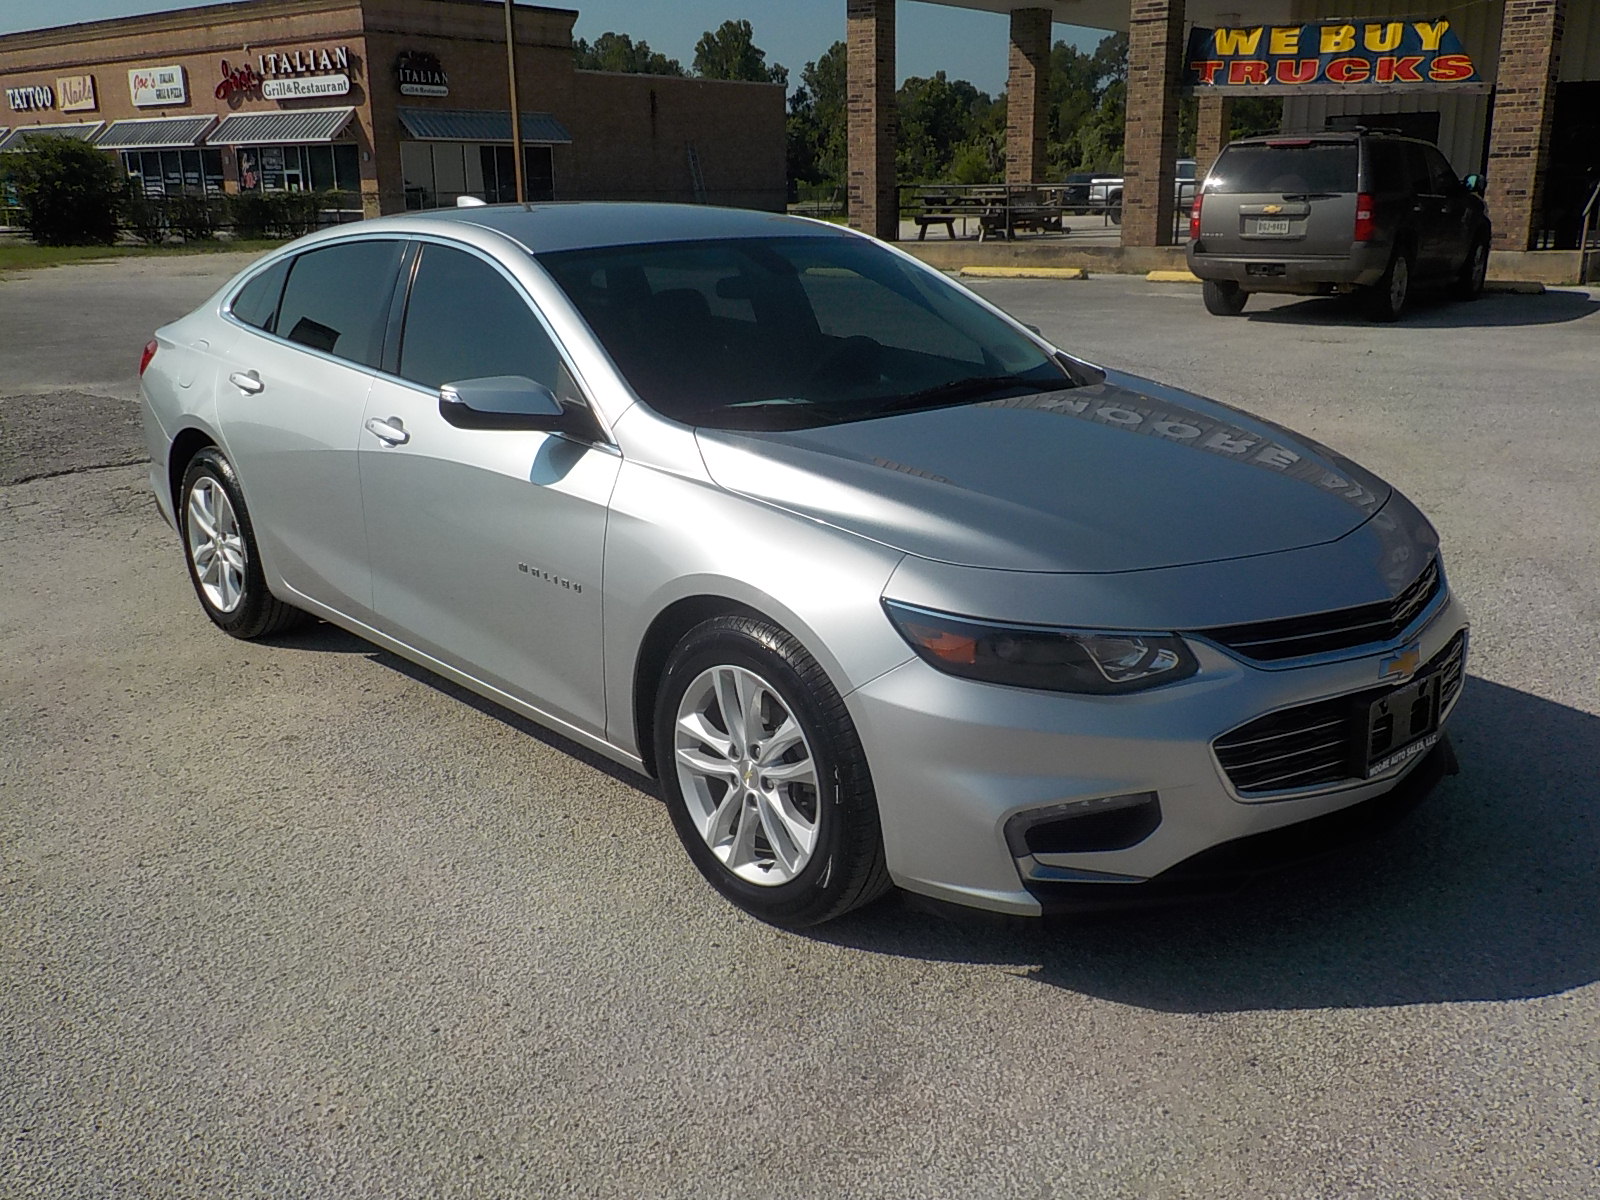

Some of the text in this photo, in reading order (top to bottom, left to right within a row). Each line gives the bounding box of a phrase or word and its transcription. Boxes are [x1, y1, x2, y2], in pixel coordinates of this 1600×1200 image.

[1214, 20, 1450, 56] WE BUY
[258, 46, 349, 75] ITALIAN
[1190, 54, 1475, 85] TRUCKS
[133, 71, 156, 101] Joe's
[399, 68, 448, 85] ITALIAN
[6, 85, 52, 110] TATTOO
[62, 77, 93, 107] Nails
[1369, 758, 1390, 776] MOORE
[1391, 750, 1406, 765] AUTO
[1425, 734, 1437, 747] LLC
